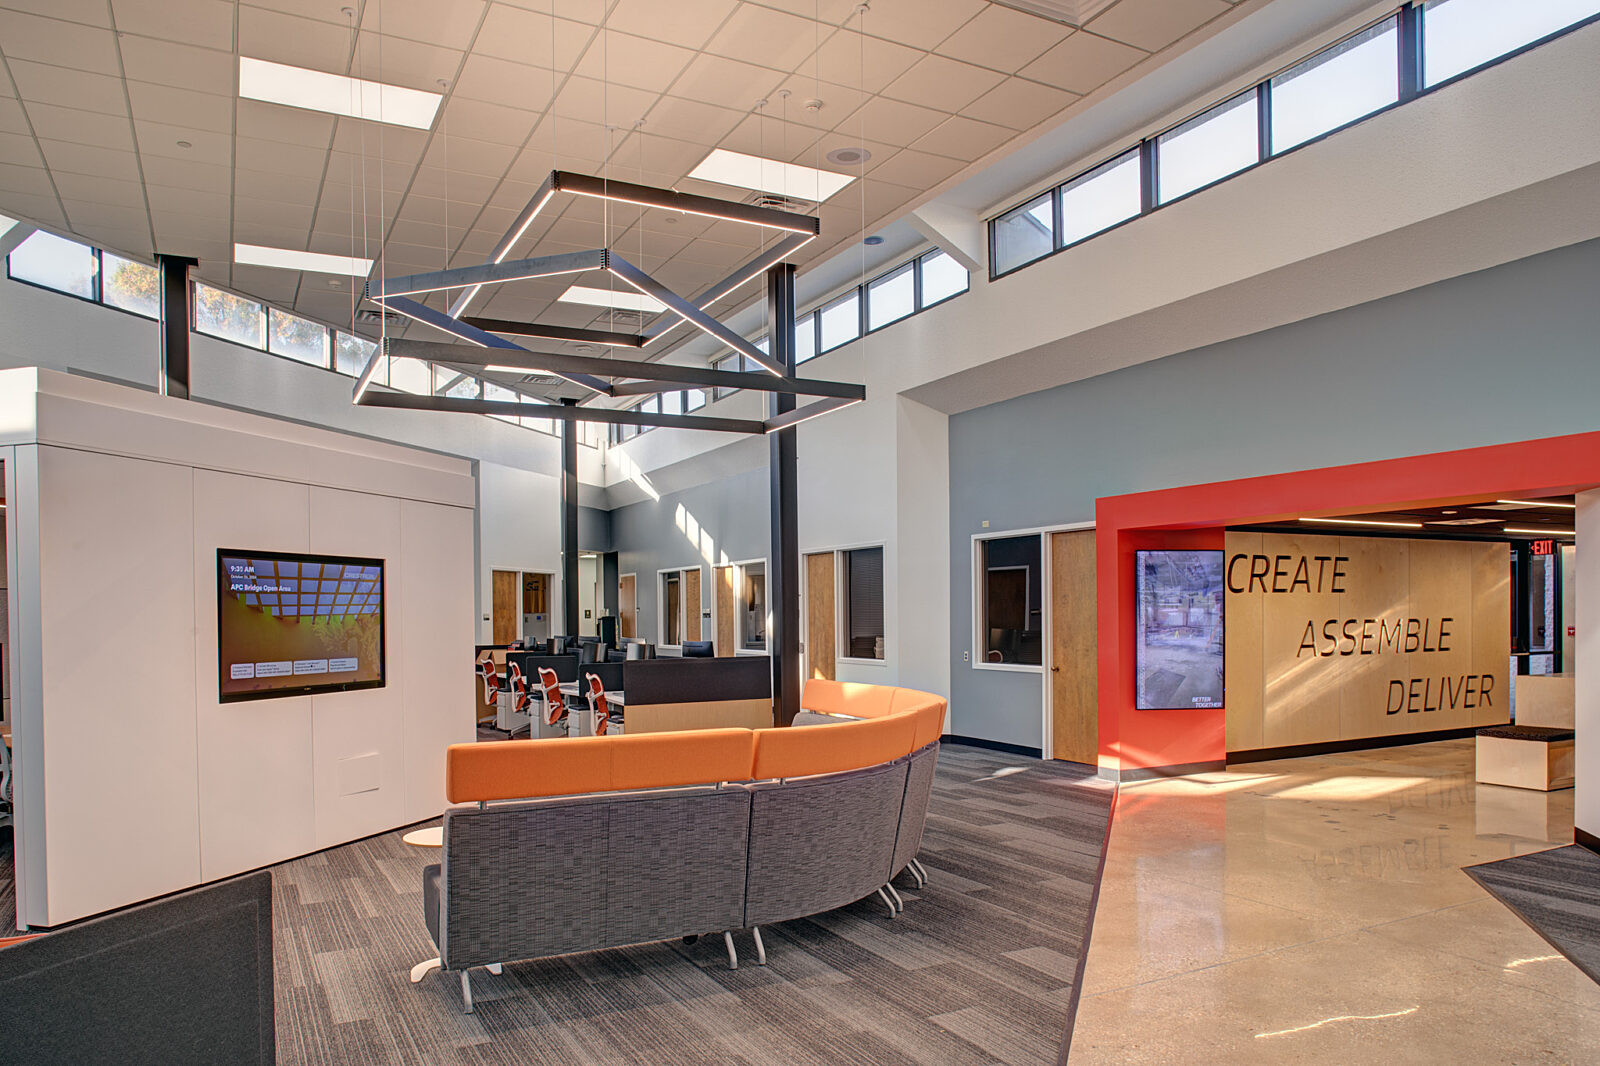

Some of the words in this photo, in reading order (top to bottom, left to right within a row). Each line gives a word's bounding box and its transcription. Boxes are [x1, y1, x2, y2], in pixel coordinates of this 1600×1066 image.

[1534, 540, 1553, 555] EXIT
[244, 584, 262, 592] Bridge
[262, 585, 278, 593] Open
[1227, 554, 1349, 593] CREATE
[1297, 618, 1453, 658] ASSEMBLE
[1386, 674, 1494, 716] DELIVER
